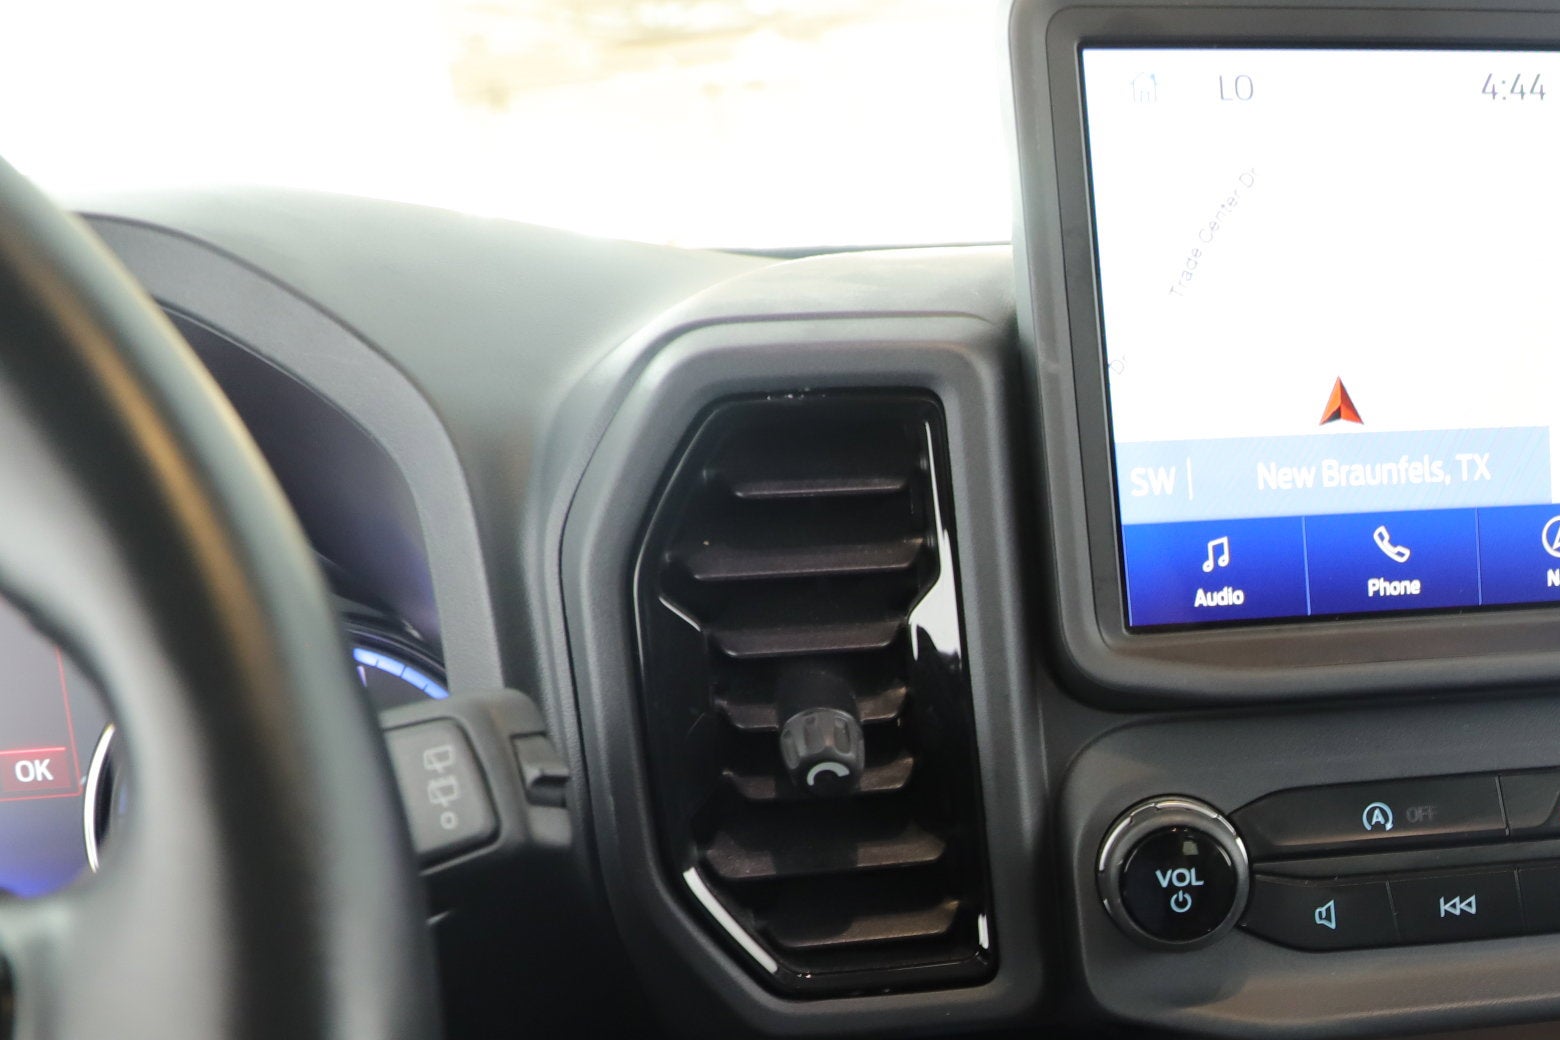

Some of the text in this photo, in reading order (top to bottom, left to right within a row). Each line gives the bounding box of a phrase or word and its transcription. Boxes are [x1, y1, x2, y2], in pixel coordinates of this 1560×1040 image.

[1218, 74, 1254, 101] LO
[1480, 73, 1547, 101] 4:44
[1167, 166, 1260, 300] Trade Center Dr
[1129, 466, 1177, 496] SW
[1256, 452, 1492, 490] New Braunfels, TX
[1194, 586, 1244, 608] Audio
[1367, 577, 1421, 597] Phone
[14, 758, 54, 784] OK
[1406, 804, 1437, 824] OFF
[1156, 867, 1204, 889] VOL
